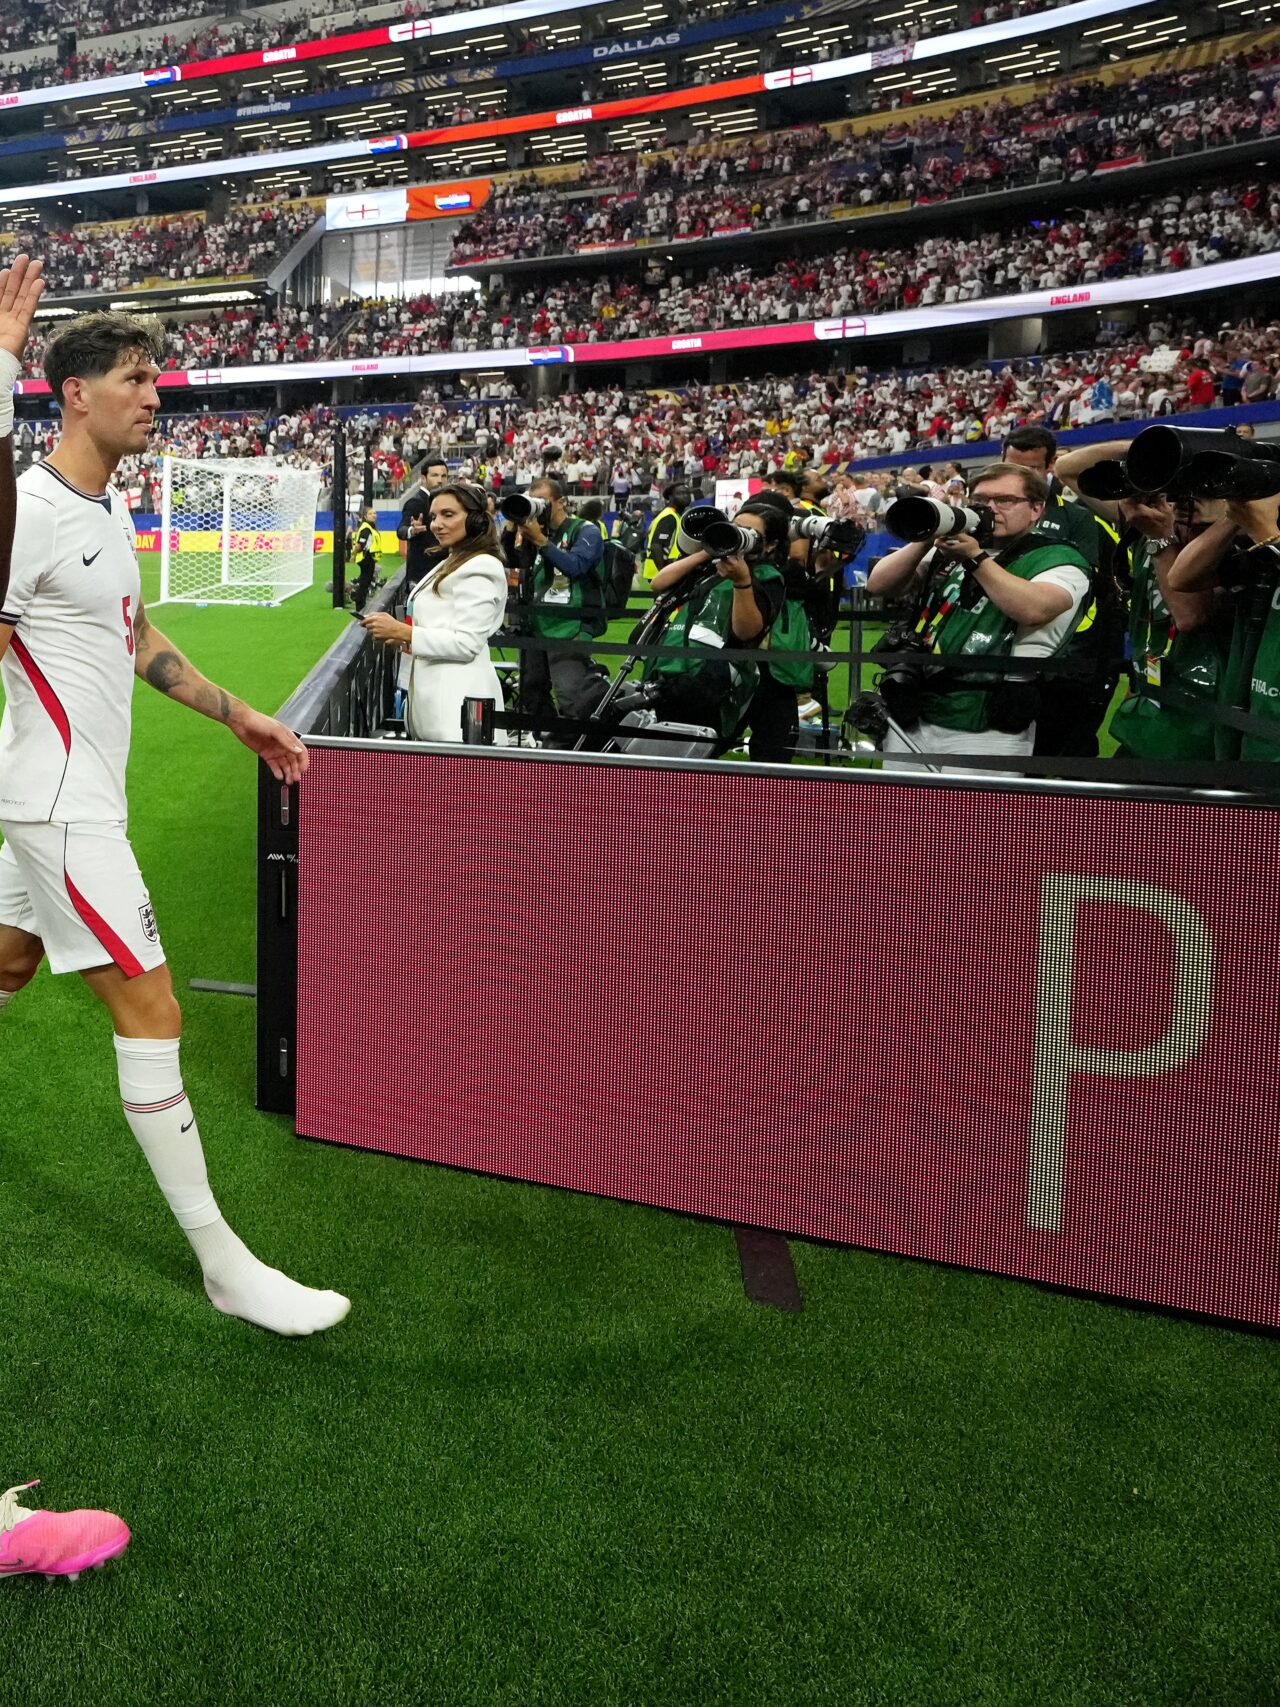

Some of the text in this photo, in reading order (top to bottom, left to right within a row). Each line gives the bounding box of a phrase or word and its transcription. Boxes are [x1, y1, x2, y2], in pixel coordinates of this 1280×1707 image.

[592, 33, 681, 58] DALLAS
[129, 173, 157, 184] ENGLAND
[1050, 292, 1091, 306] ENGLAND
[351, 364, 379, 372] ENGLAND
[135, 534, 156, 549] DAY
[122, 595, 134, 656] 5
[1026, 872, 1213, 1232] P
